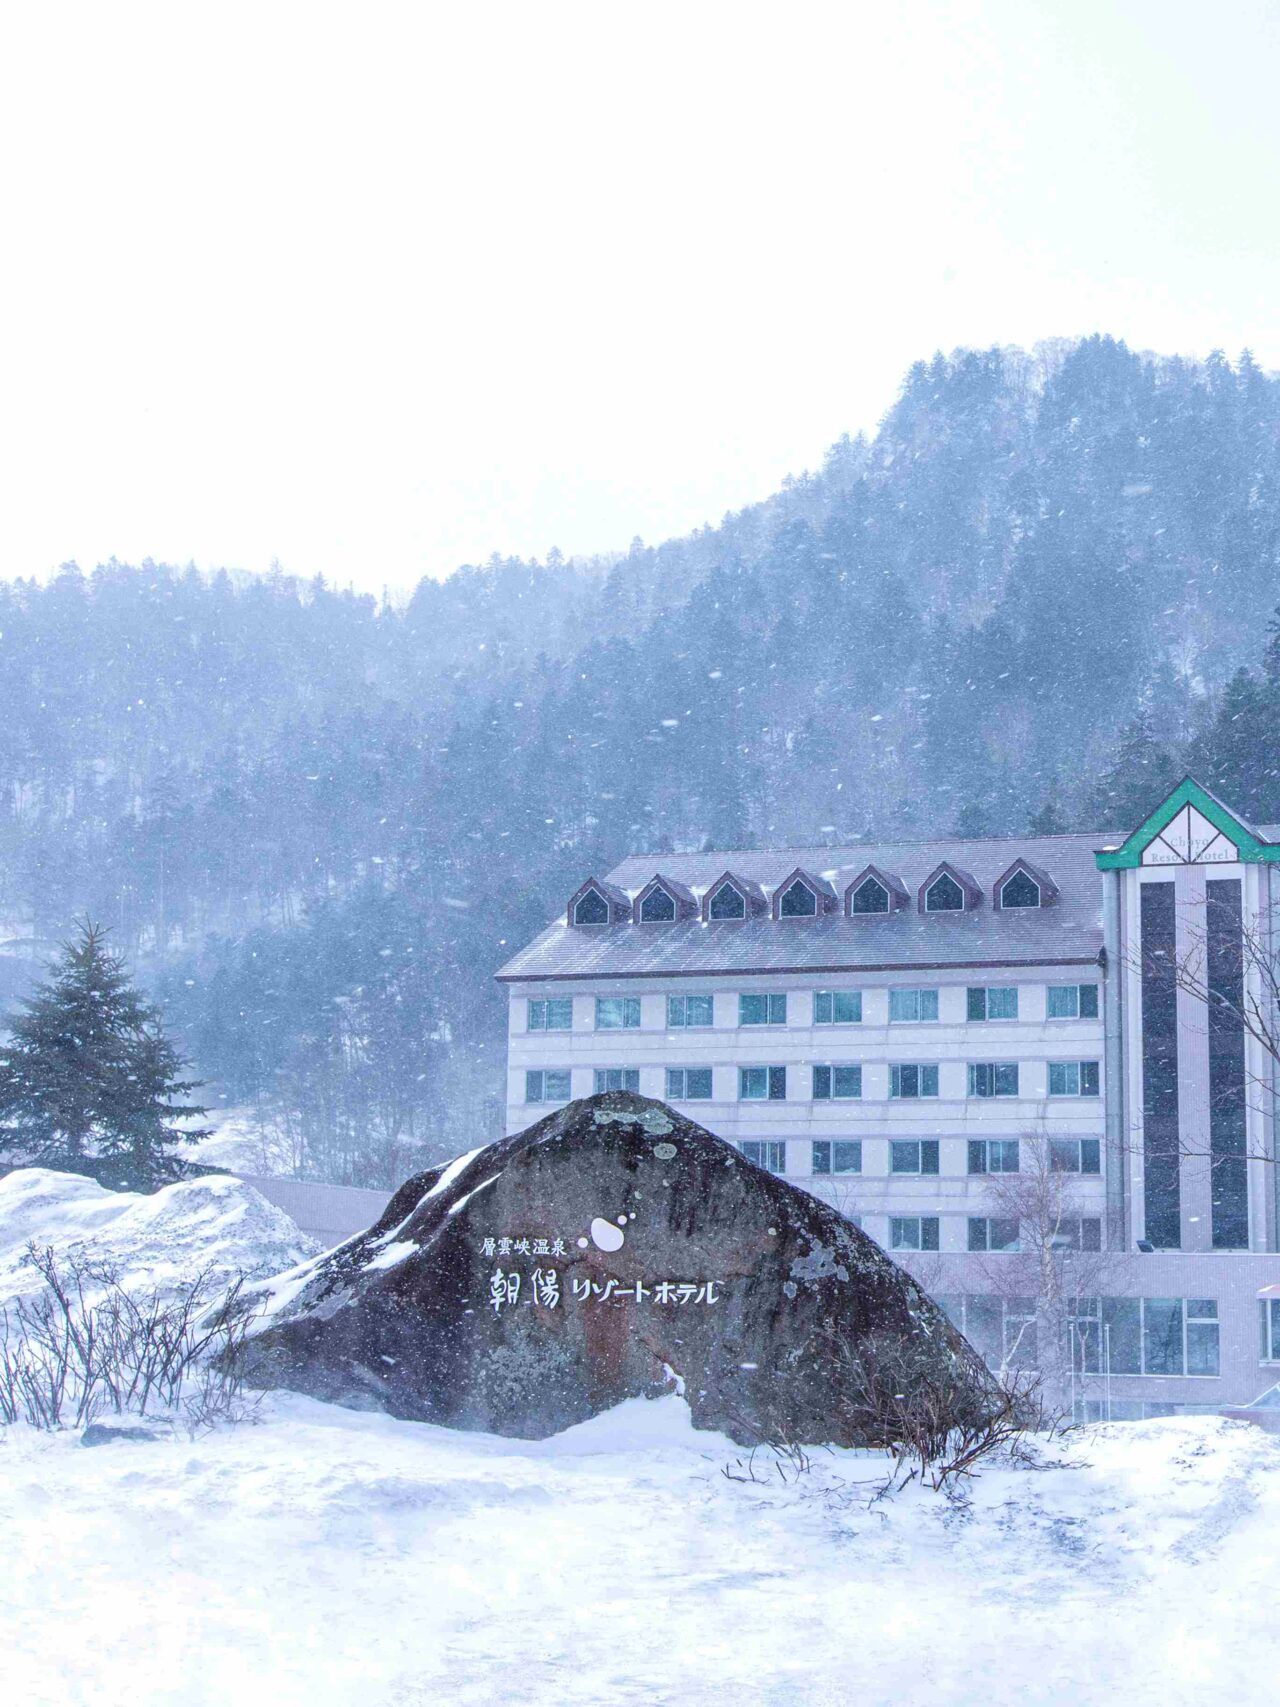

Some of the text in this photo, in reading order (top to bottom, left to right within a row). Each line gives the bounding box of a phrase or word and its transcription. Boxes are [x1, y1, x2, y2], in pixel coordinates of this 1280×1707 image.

[480, 1237, 567, 1256] 層雲峡温泉
